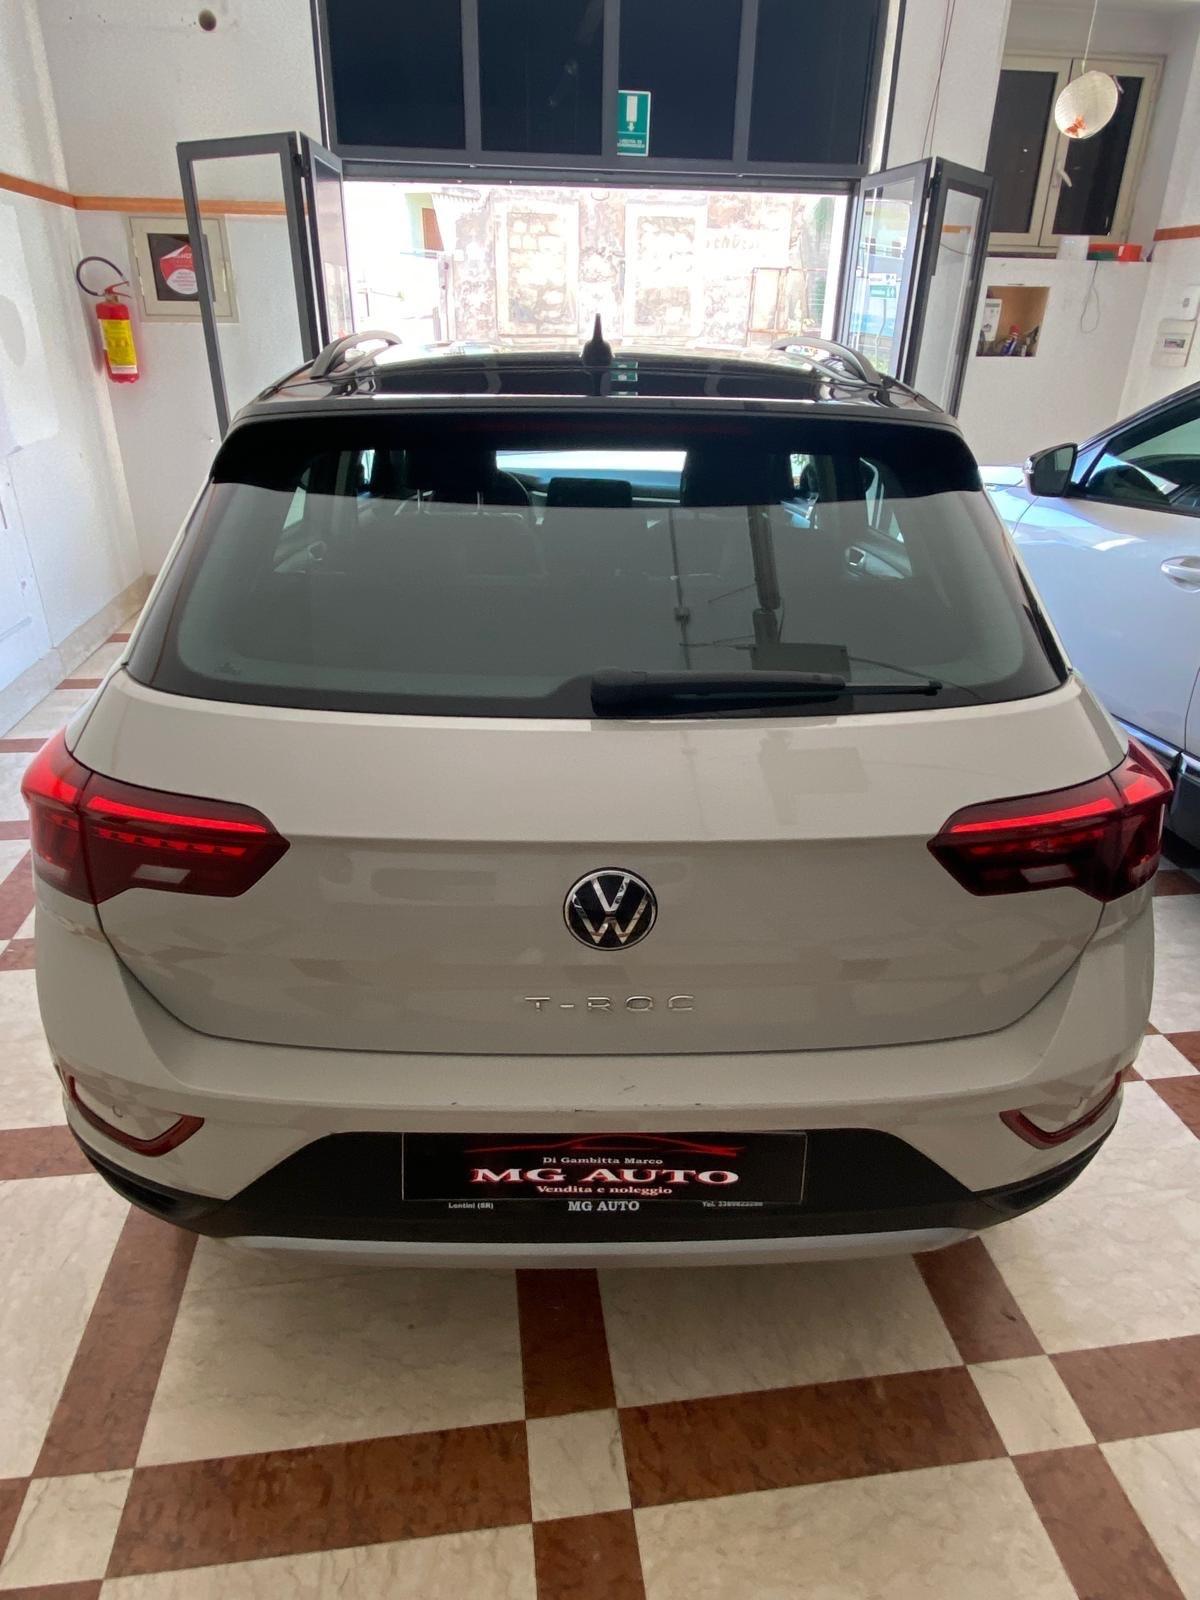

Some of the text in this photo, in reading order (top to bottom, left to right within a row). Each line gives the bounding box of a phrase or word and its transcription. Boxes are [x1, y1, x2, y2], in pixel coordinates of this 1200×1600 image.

[569, 870, 650, 945] VW
[524, 995, 695, 1012] T-ROC
[624, 1157, 664, 1165] Marco
[471, 1167, 740, 1184] MG AUTO
[536, 1185, 593, 1193] Vendita
[609, 1186, 673, 1196] noleggio
[568, 1200, 640, 1211] MG AUTO
